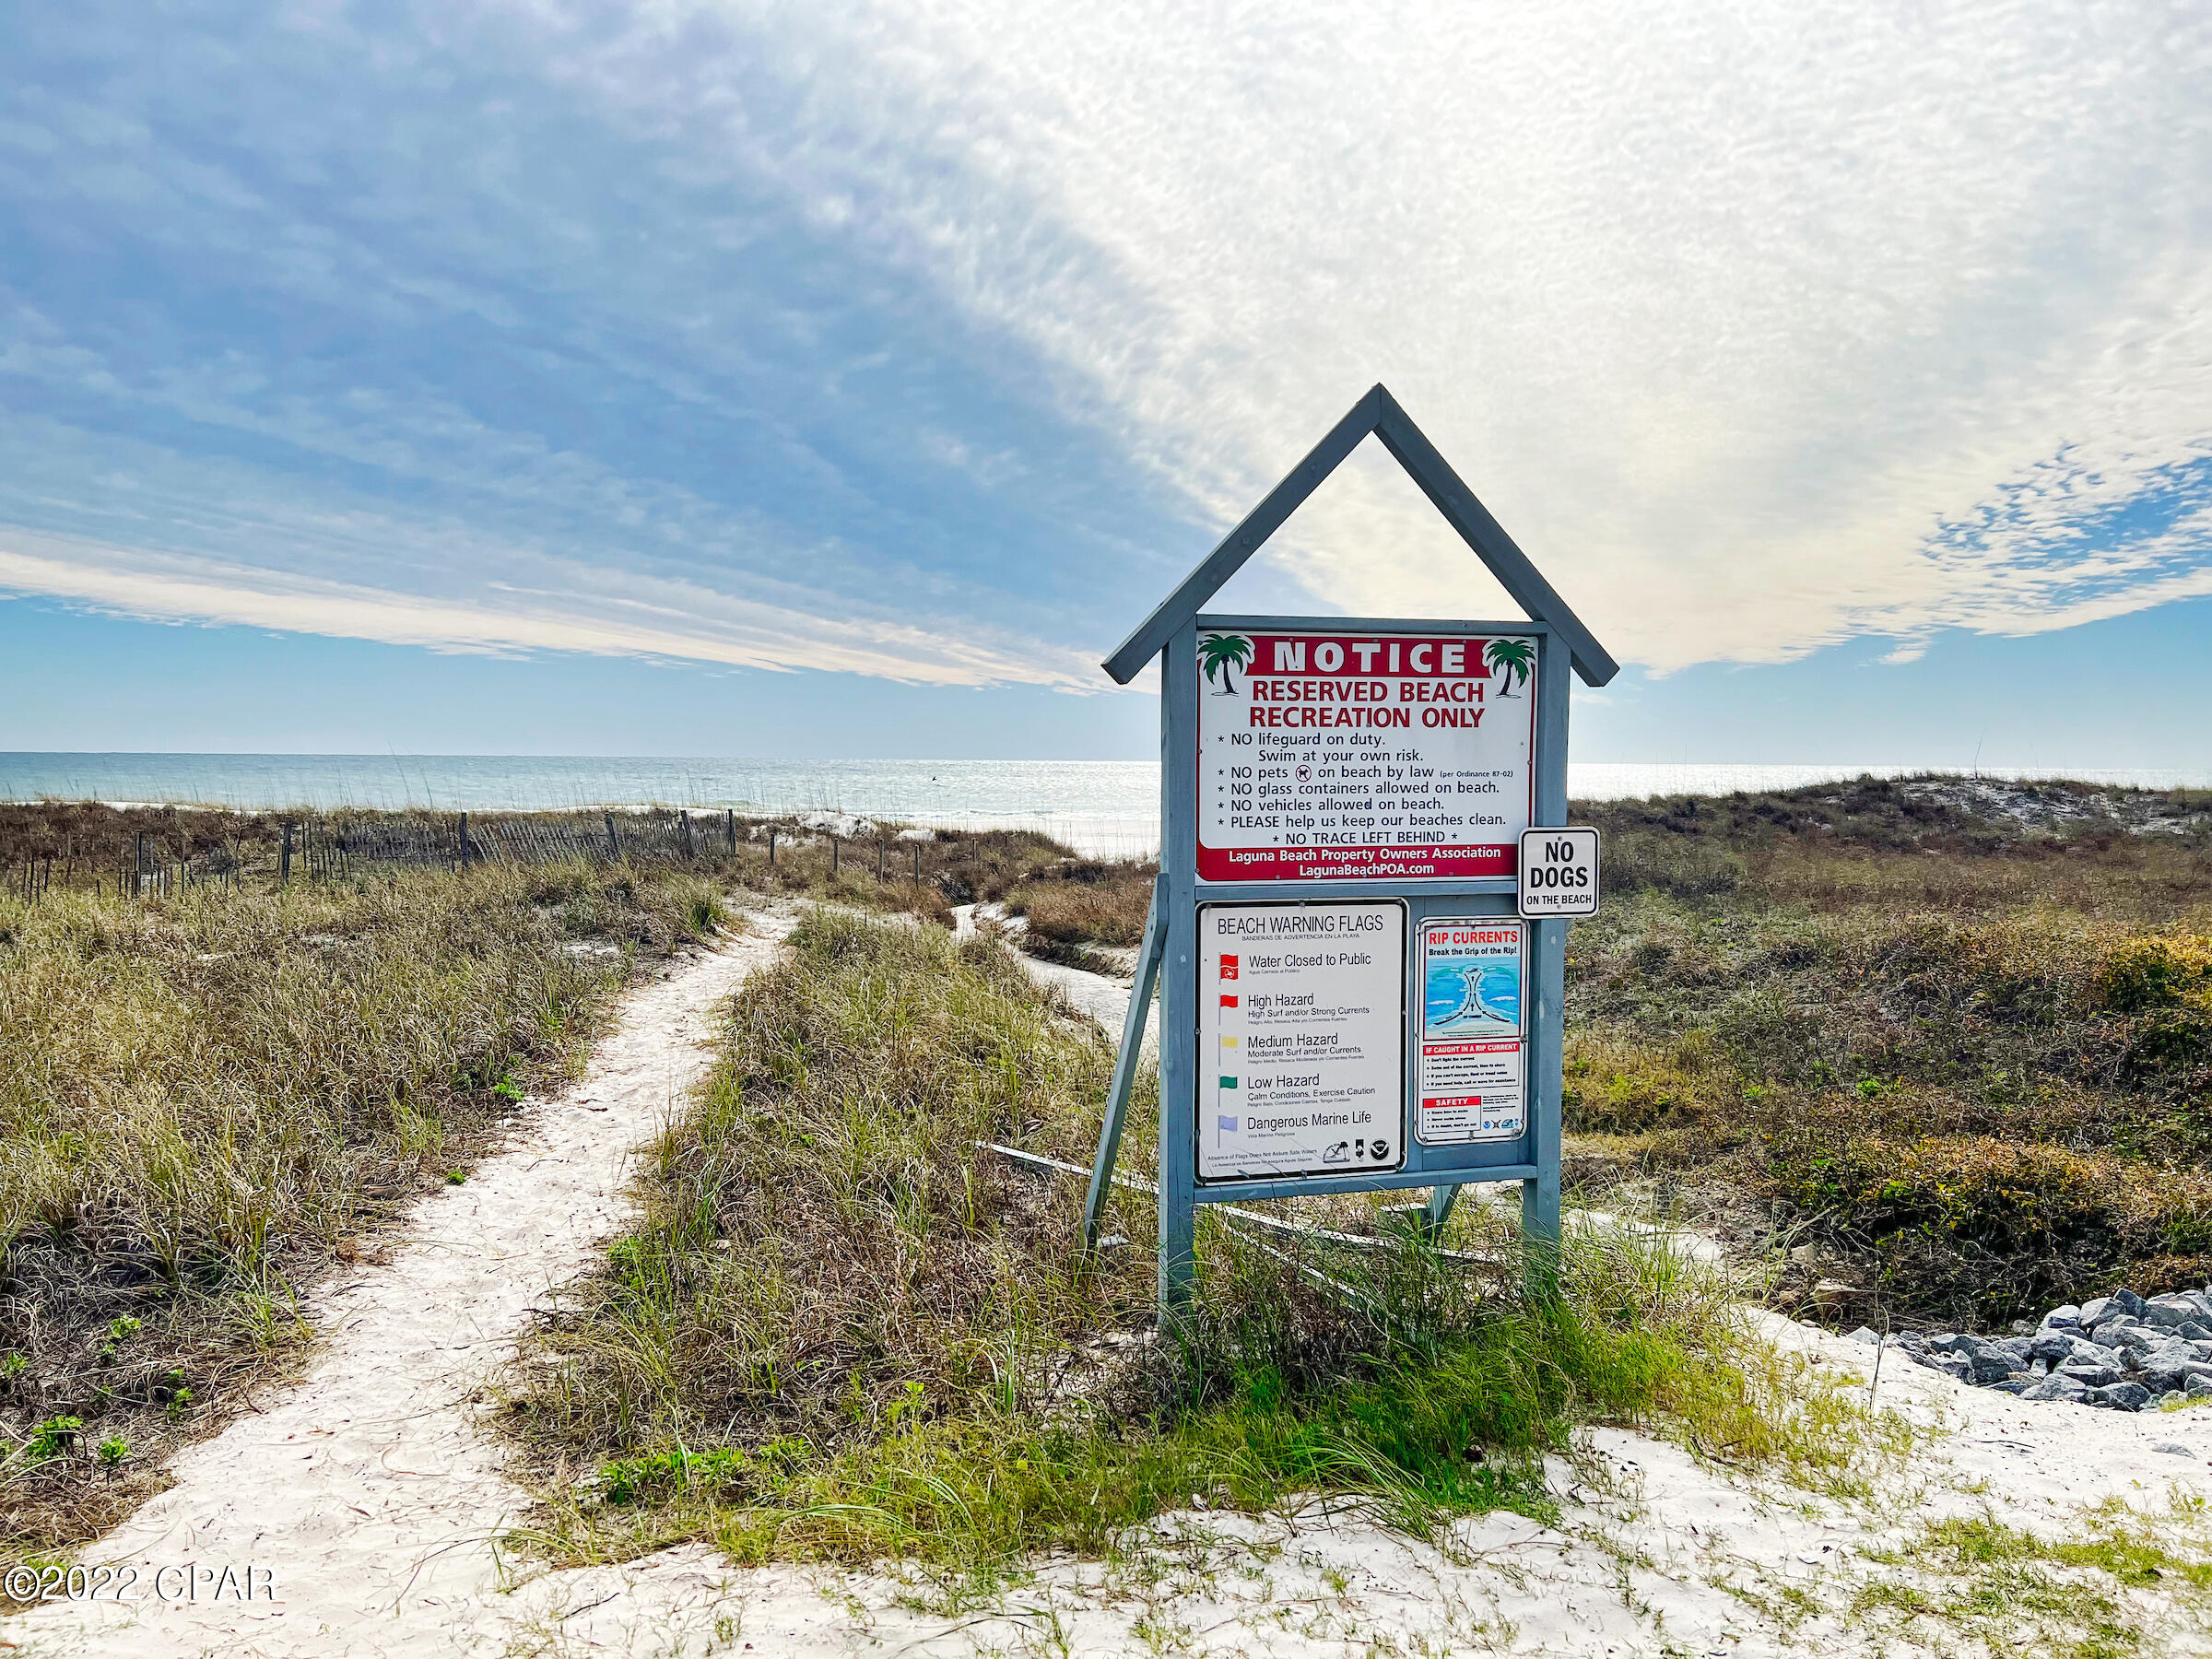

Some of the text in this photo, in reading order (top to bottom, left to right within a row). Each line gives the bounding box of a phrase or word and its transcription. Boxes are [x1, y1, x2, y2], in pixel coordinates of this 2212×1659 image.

[1274, 641, 1465, 673] NOTICE
[1253, 681, 1484, 702] RESERVED BEACH
[1250, 707, 1486, 728] RECREATION ONLY
[1231, 733, 1385, 748] NO lifeguard on duty.
[1258, 748, 1423, 764] Swim at your own risk.
[1231, 767, 1252, 778] NO
[1258, 768, 1288, 781] pets
[1318, 769, 1335, 778] on
[1341, 765, 1381, 778] beach
[1387, 765, 1404, 780] by
[1410, 765, 1434, 778] law
[1440, 771, 1453, 779] (per
[1492, 770, 1513, 778] 87-02)
[1231, 781, 1500, 797] NO glass containers allowed on beach.
[1231, 797, 1444, 811] NO vehicles allowed on beach.
[1231, 813, 1506, 830] PLEASE help us keep our beaches clean.
[1286, 831, 1445, 844] NO TRACE LEFT BEHIND
[1229, 846, 1501, 865] Laguna Beach Property Owners Association
[1546, 841, 1574, 862] NO
[1300, 863, 1434, 878] LagunaBeachPOA.com
[1531, 866, 1588, 888] DOGS
[1527, 894, 1592, 904] ON THE BEACH
[1218, 915, 1383, 935] BEACH WARNING FLAGS
[1429, 931, 1518, 945] RIP CURRENTS
[1465, 947, 1479, 956] Grip
[1503, 946, 1517, 955] Rip!
[1249, 952, 1371, 968] Water Closed to Public
[1248, 993, 1314, 1010] High Hazard
[1248, 1006, 1370, 1019] High Surf and/or Strong Currents
[1248, 1032, 1338, 1049] Medium Hazard
[1248, 1046, 1361, 1058] Moderate Surf and/or Currents
[1247, 1074, 1320, 1089] Low Hazard
[1247, 1088, 1375, 1101] Calm Conditions, Exercise Caution
[1247, 1111, 1371, 1132] Dangerous Marine Life
